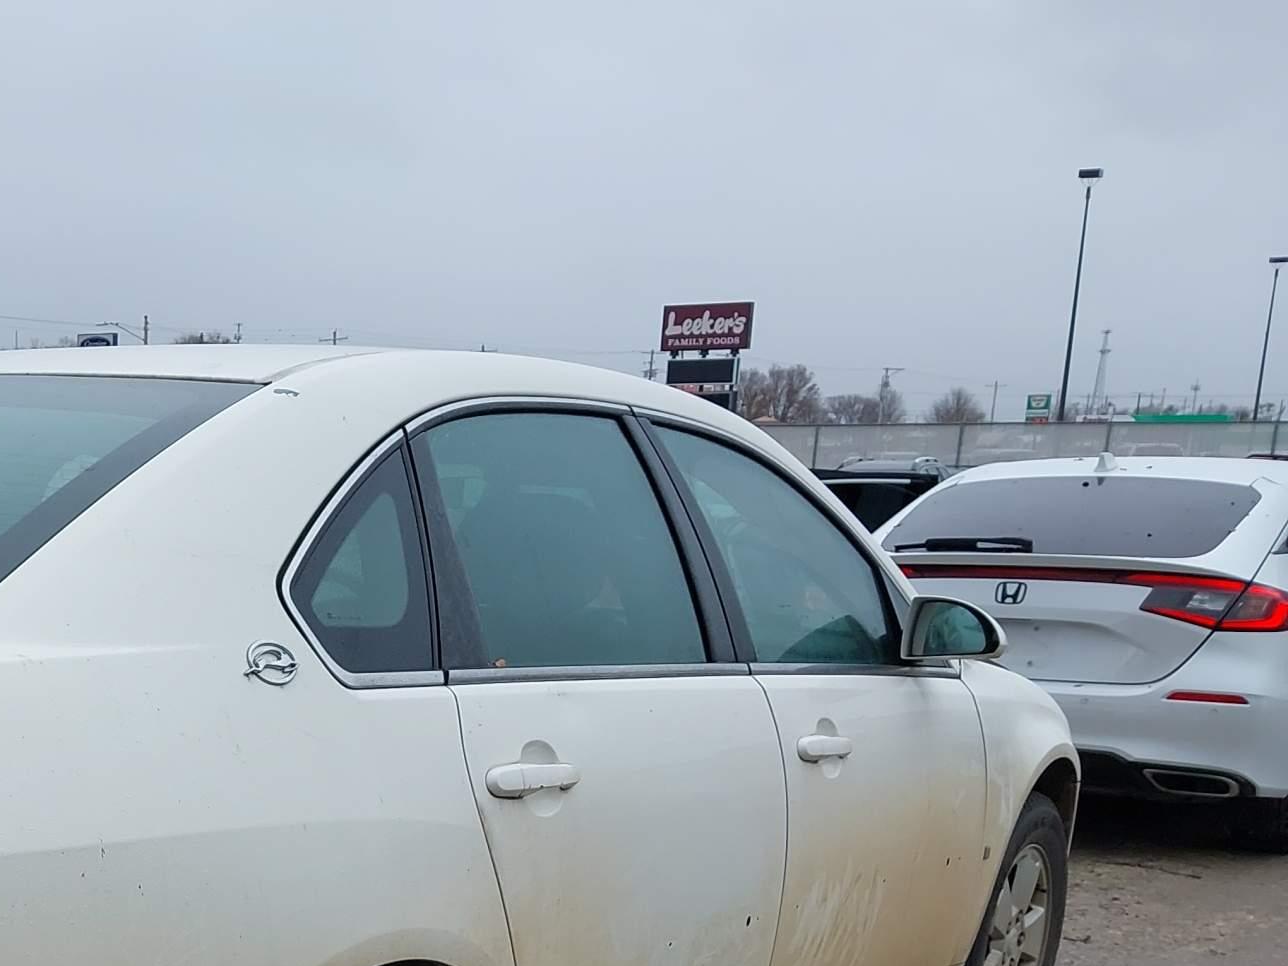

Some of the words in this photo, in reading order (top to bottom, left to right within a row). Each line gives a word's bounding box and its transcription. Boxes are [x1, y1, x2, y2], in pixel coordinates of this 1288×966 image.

[665, 310, 747, 335] Leeker's
[668, 338, 705, 346] FAMILY
[707, 336, 740, 345] FOODS
